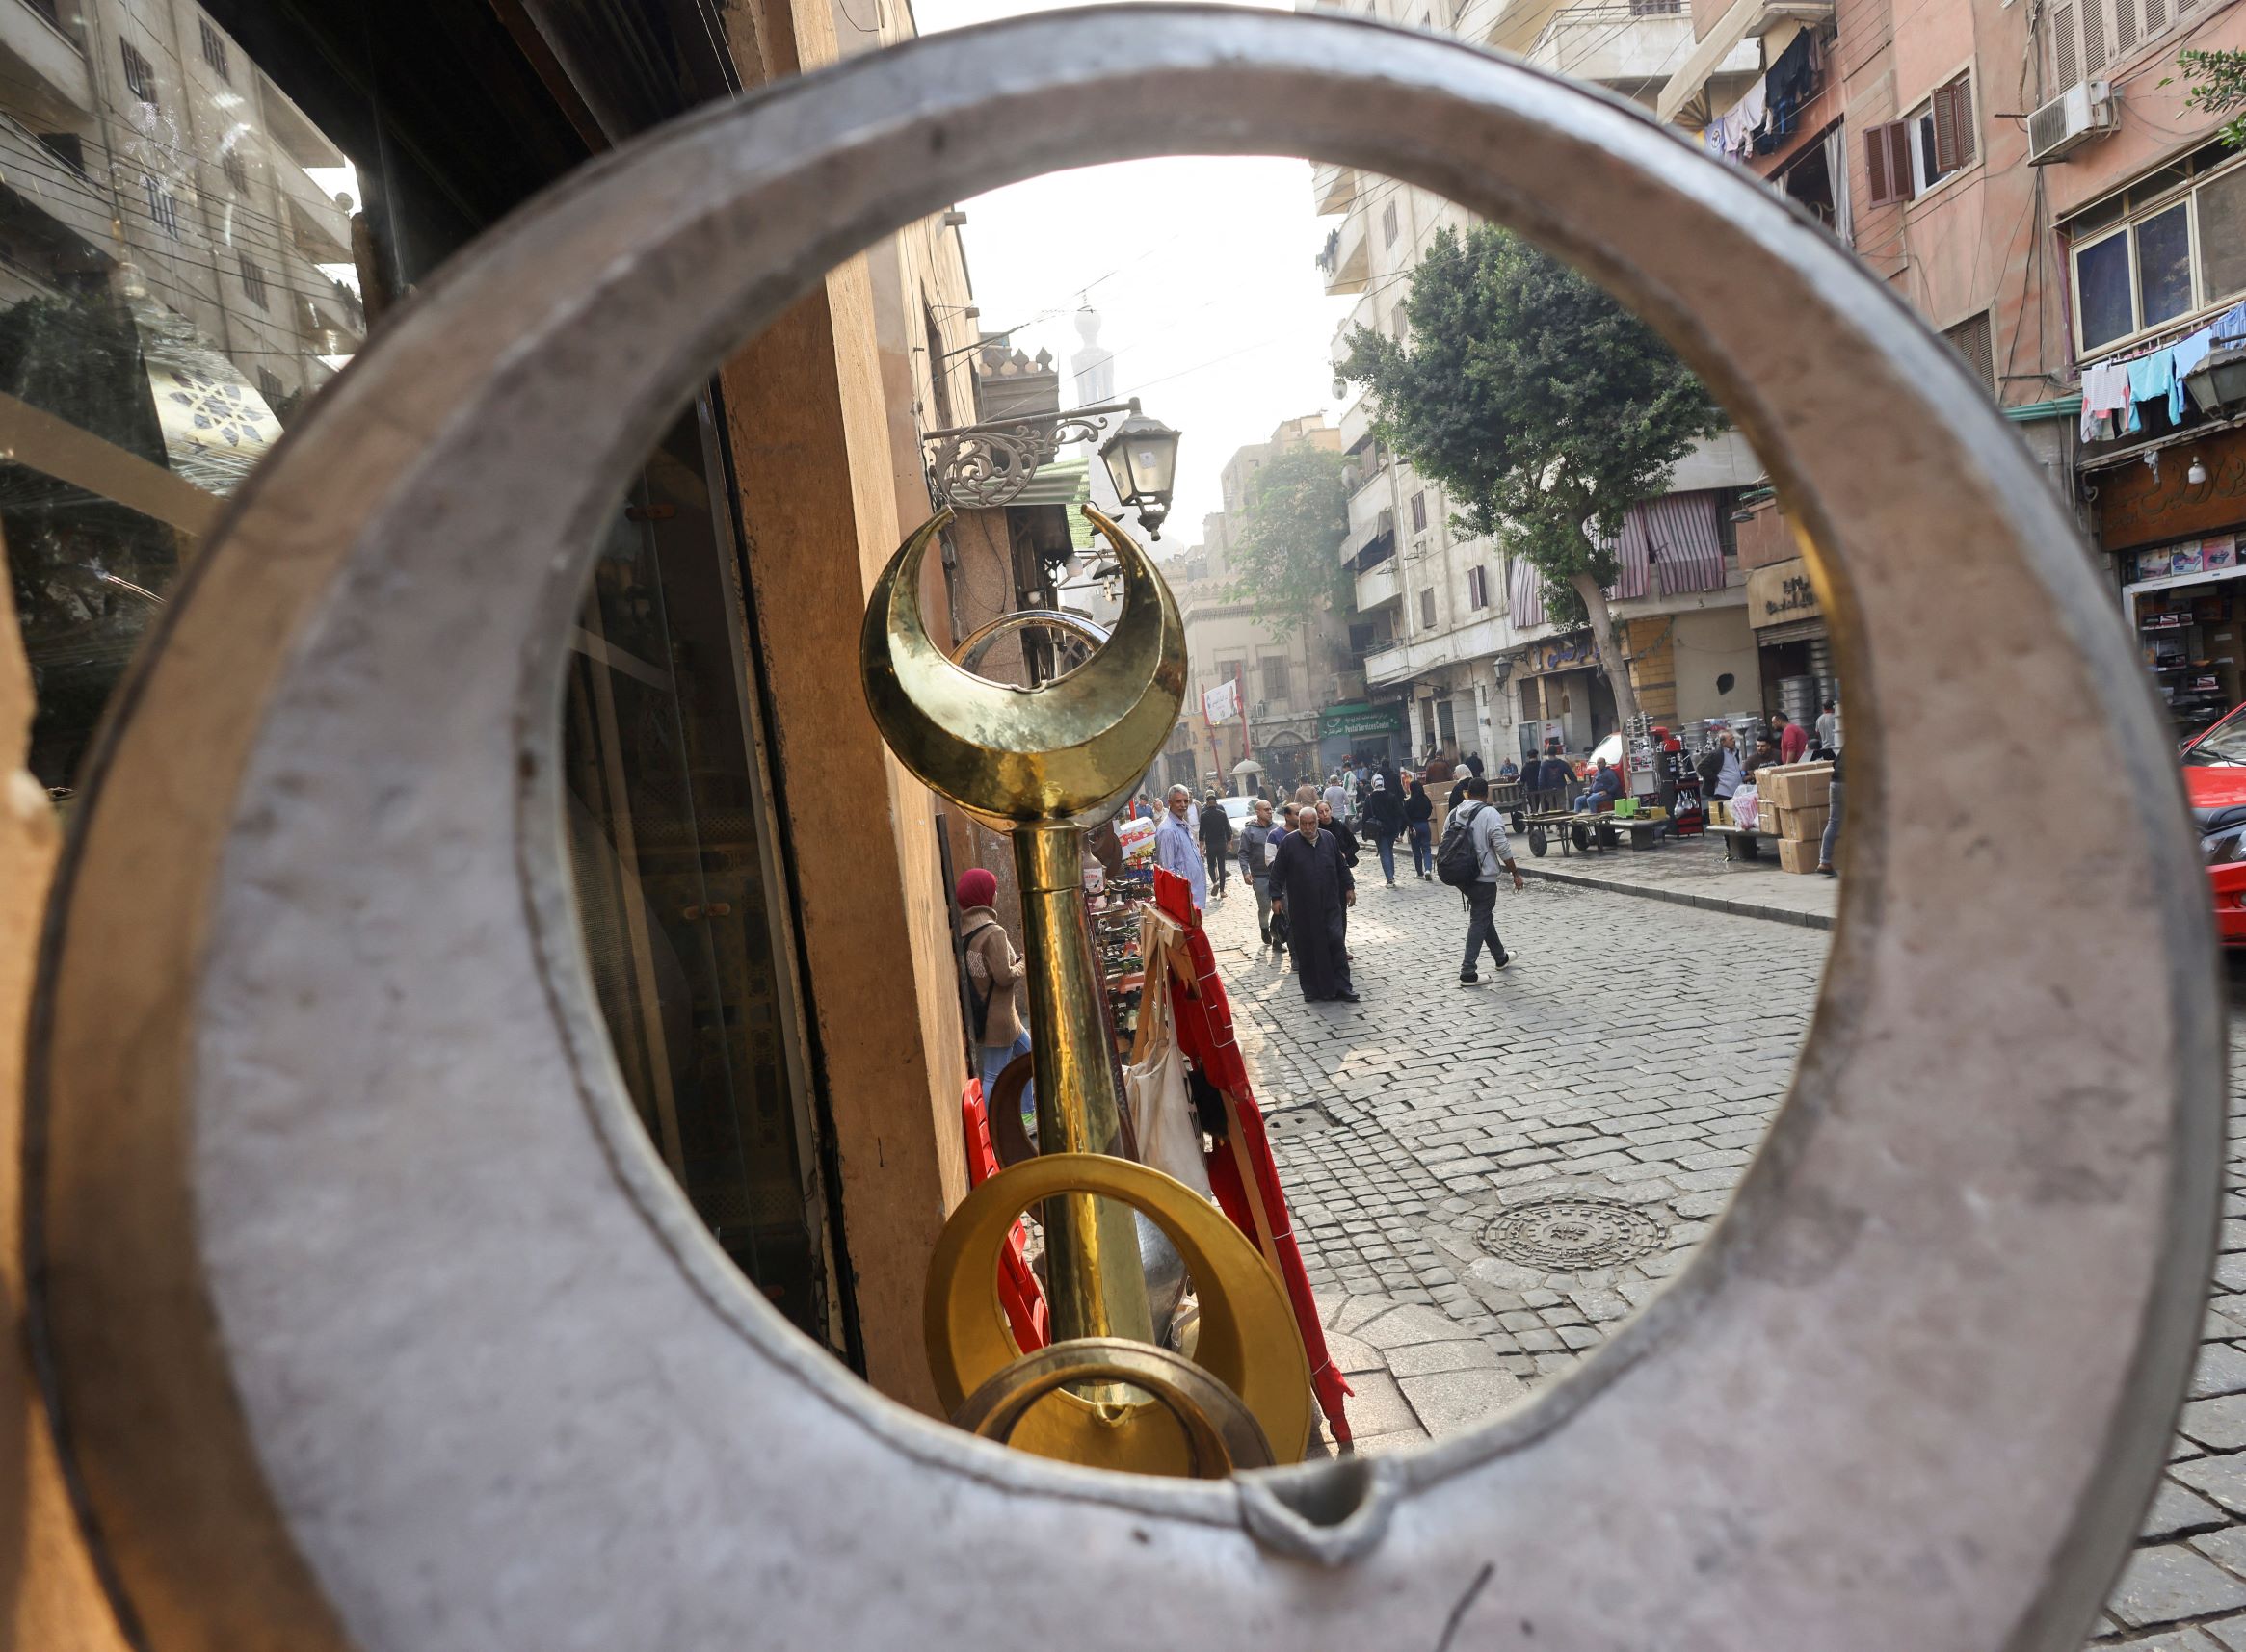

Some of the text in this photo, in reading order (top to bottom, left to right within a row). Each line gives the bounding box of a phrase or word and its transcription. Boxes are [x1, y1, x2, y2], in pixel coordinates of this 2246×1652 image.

[1344, 721, 1389, 733] Postal Services Center
